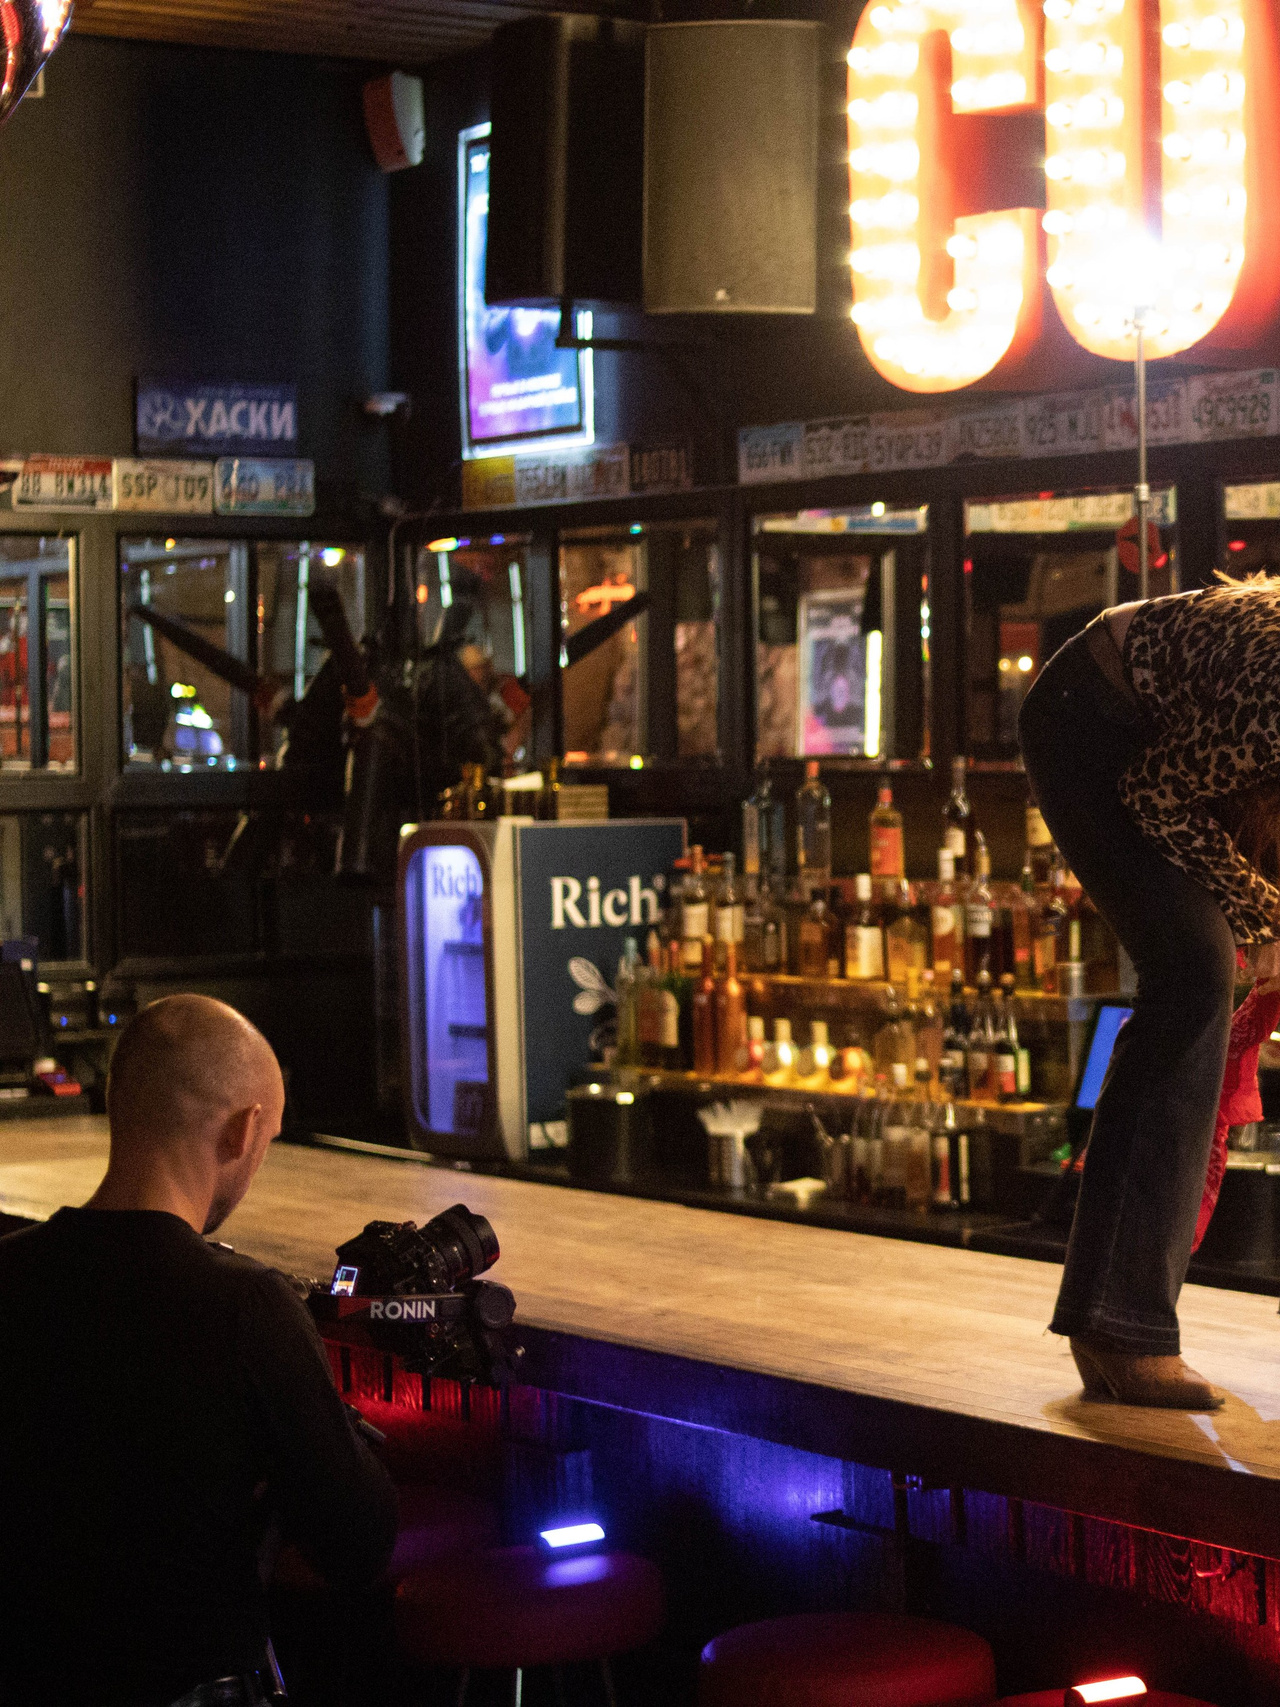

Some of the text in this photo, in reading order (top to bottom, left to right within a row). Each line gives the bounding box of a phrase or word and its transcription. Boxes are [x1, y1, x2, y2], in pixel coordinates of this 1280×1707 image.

[183, 397, 295, 441] ХАСКИ
[432, 862, 482, 900] Rich
[551, 873, 659, 931] Rich
[370, 1300, 436, 1320] RONIN
